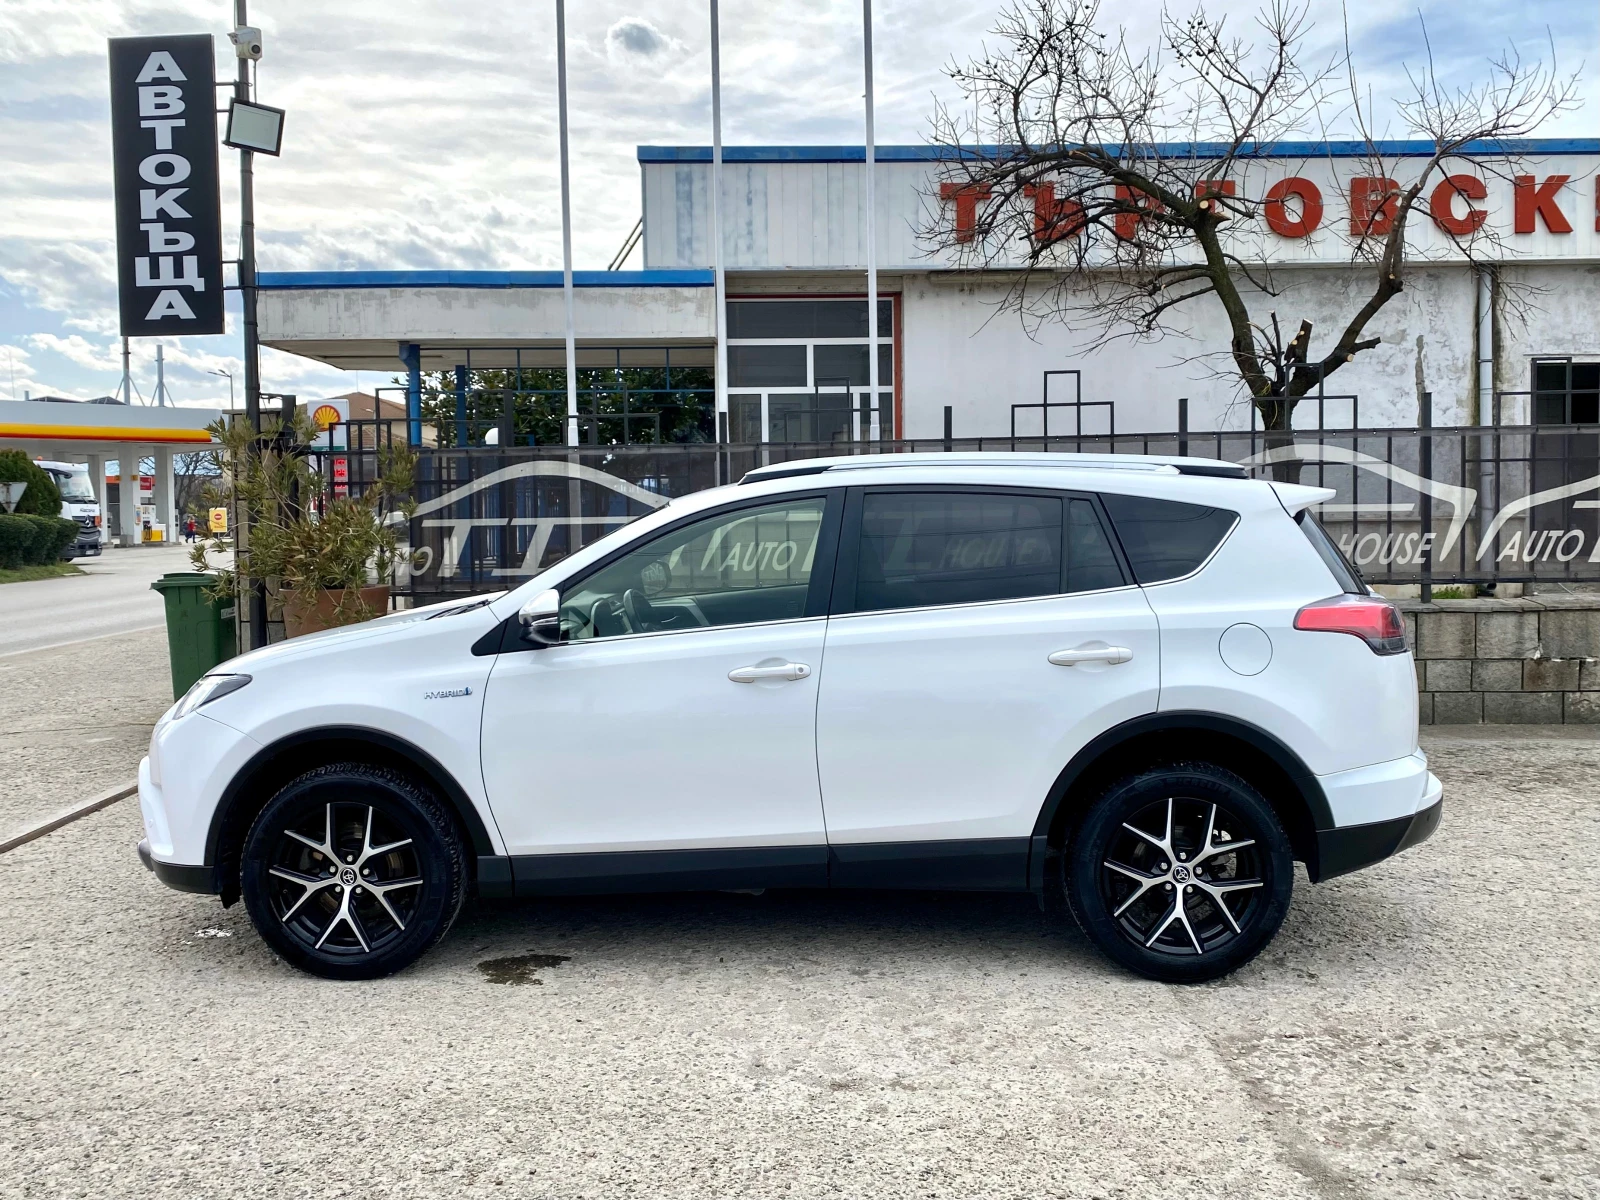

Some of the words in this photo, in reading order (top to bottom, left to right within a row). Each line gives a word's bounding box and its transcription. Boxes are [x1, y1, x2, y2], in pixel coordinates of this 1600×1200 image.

[134, 50, 205, 321] АВТОКЪЩА
[940, 174, 1600, 243] ТЪРГОВСК
[718, 541, 798, 572] AUTO
[1337, 532, 1437, 565] HOUSE
[1496, 529, 1585, 562] AUTO
[424, 688, 465, 700] HYBRID
